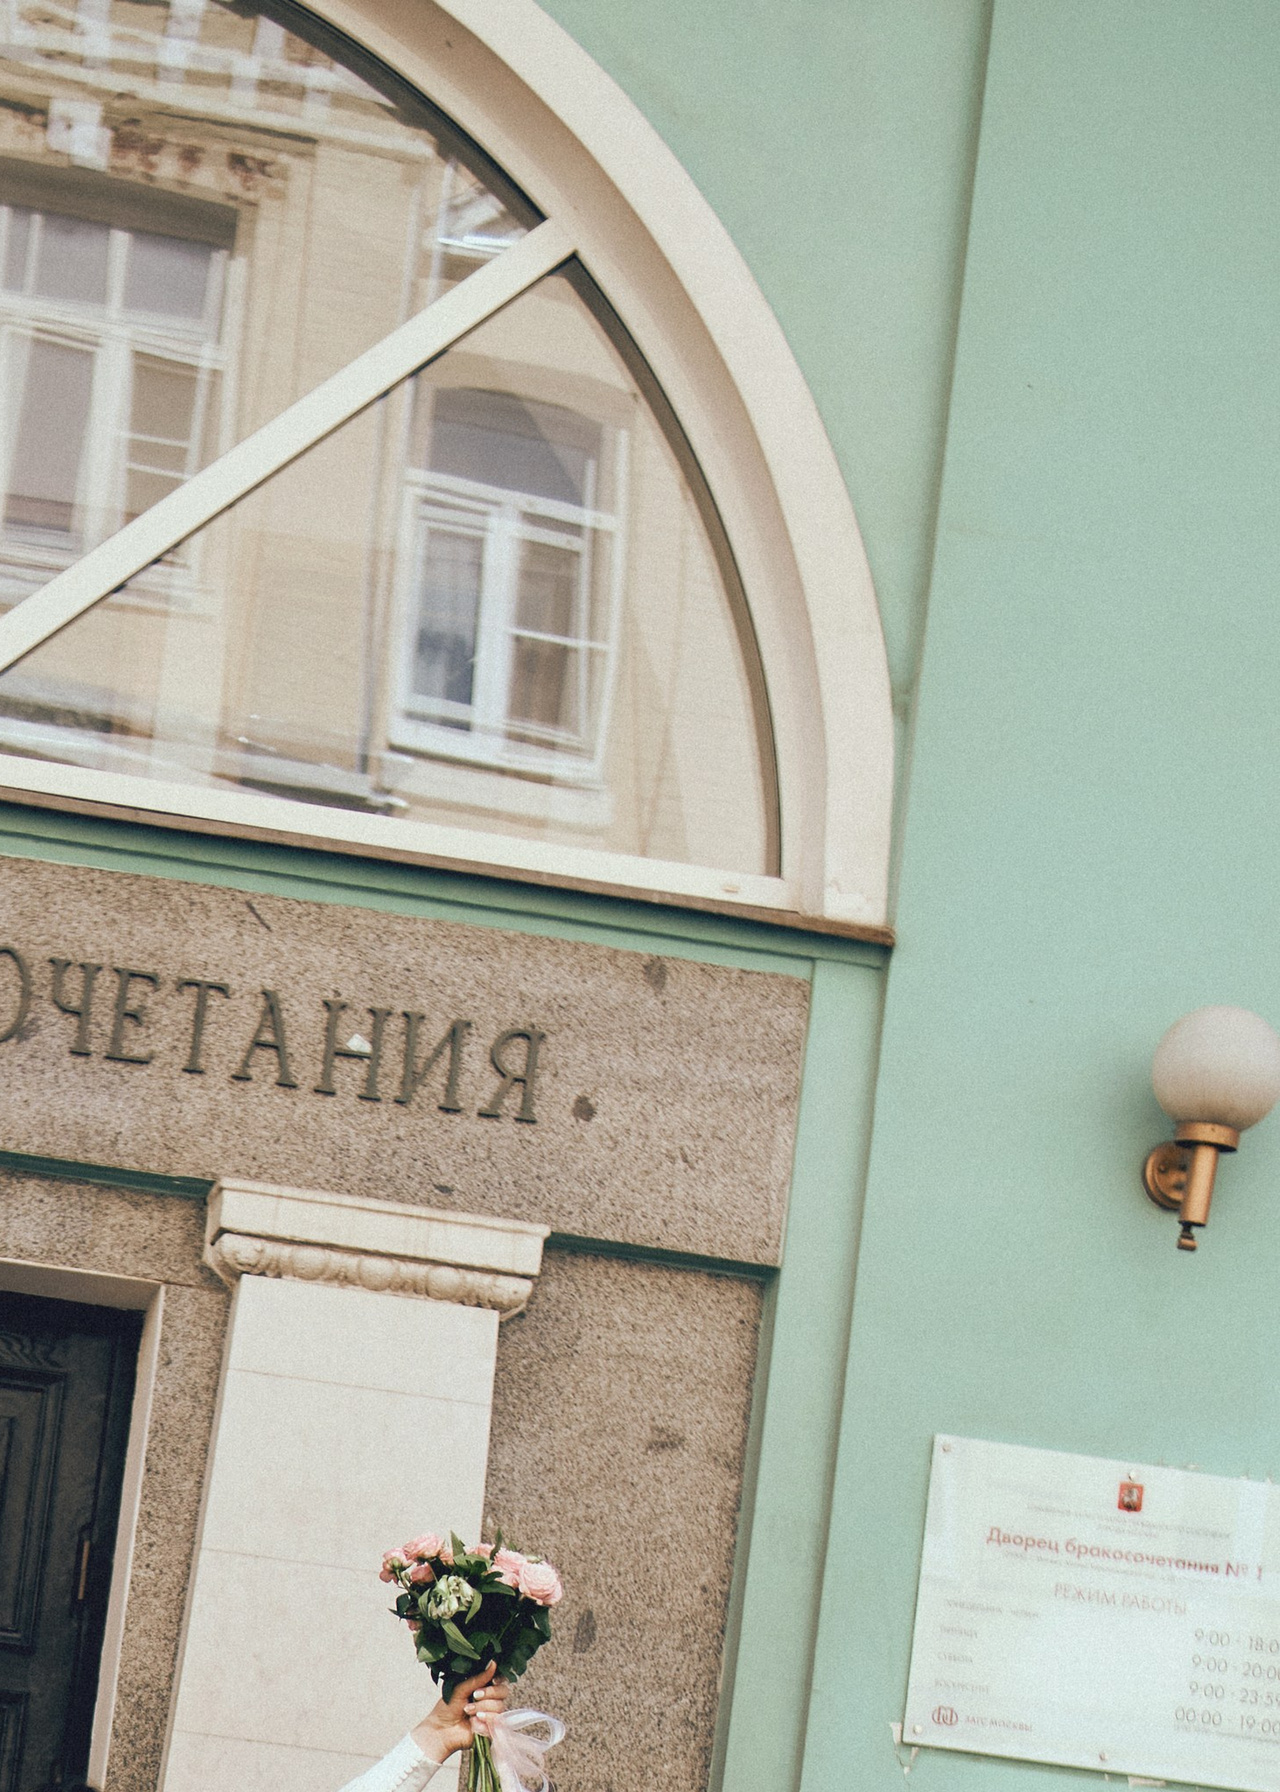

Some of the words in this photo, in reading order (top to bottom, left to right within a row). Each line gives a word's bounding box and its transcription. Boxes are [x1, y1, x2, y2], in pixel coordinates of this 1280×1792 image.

[986, 1526, 1060, 1554] Дворец
[1064, 1538, 1219, 1574] бракосочетания
[1054, 1583, 1116, 1607] РЕЖИМ
[1121, 1593, 1187, 1616] РАБОТЫ
[1249, 1635, 1280, 1654] 18:0
[1174, 1705, 1223, 1726] 00:00
